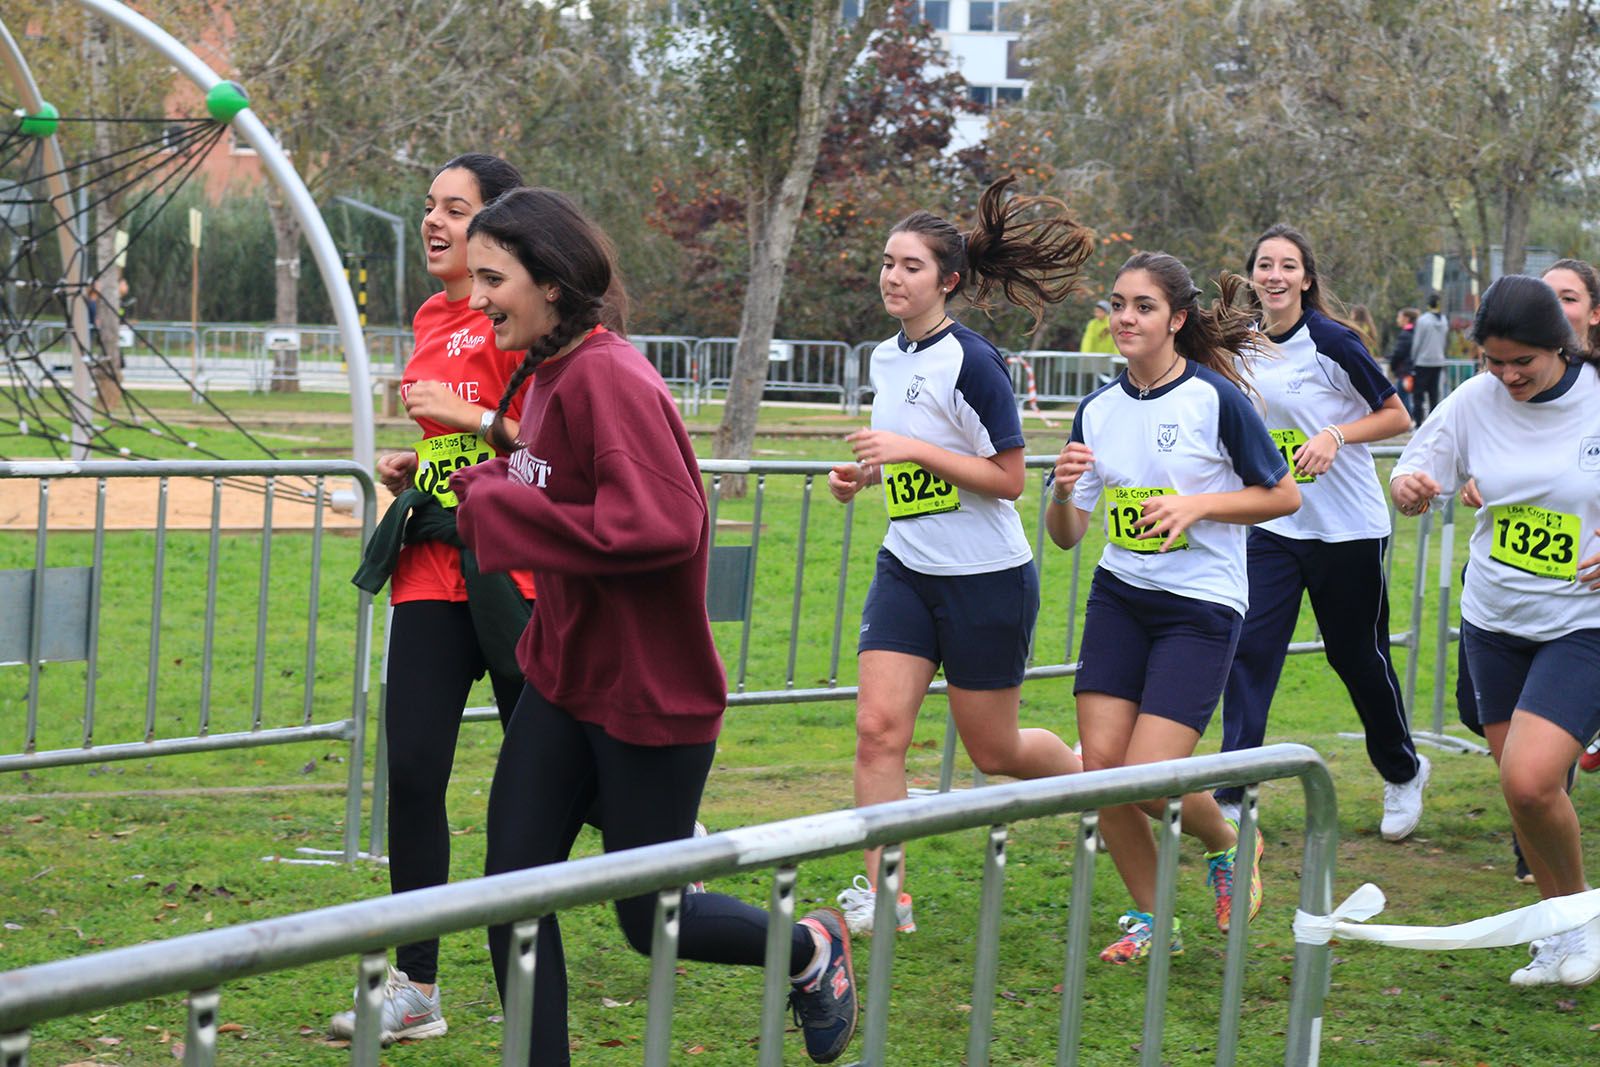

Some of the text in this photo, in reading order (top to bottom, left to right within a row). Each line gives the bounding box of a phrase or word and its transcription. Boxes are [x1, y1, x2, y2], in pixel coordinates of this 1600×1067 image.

[1115, 489, 1150, 499] 18è Cros
[1497, 518, 1574, 564] 1323
